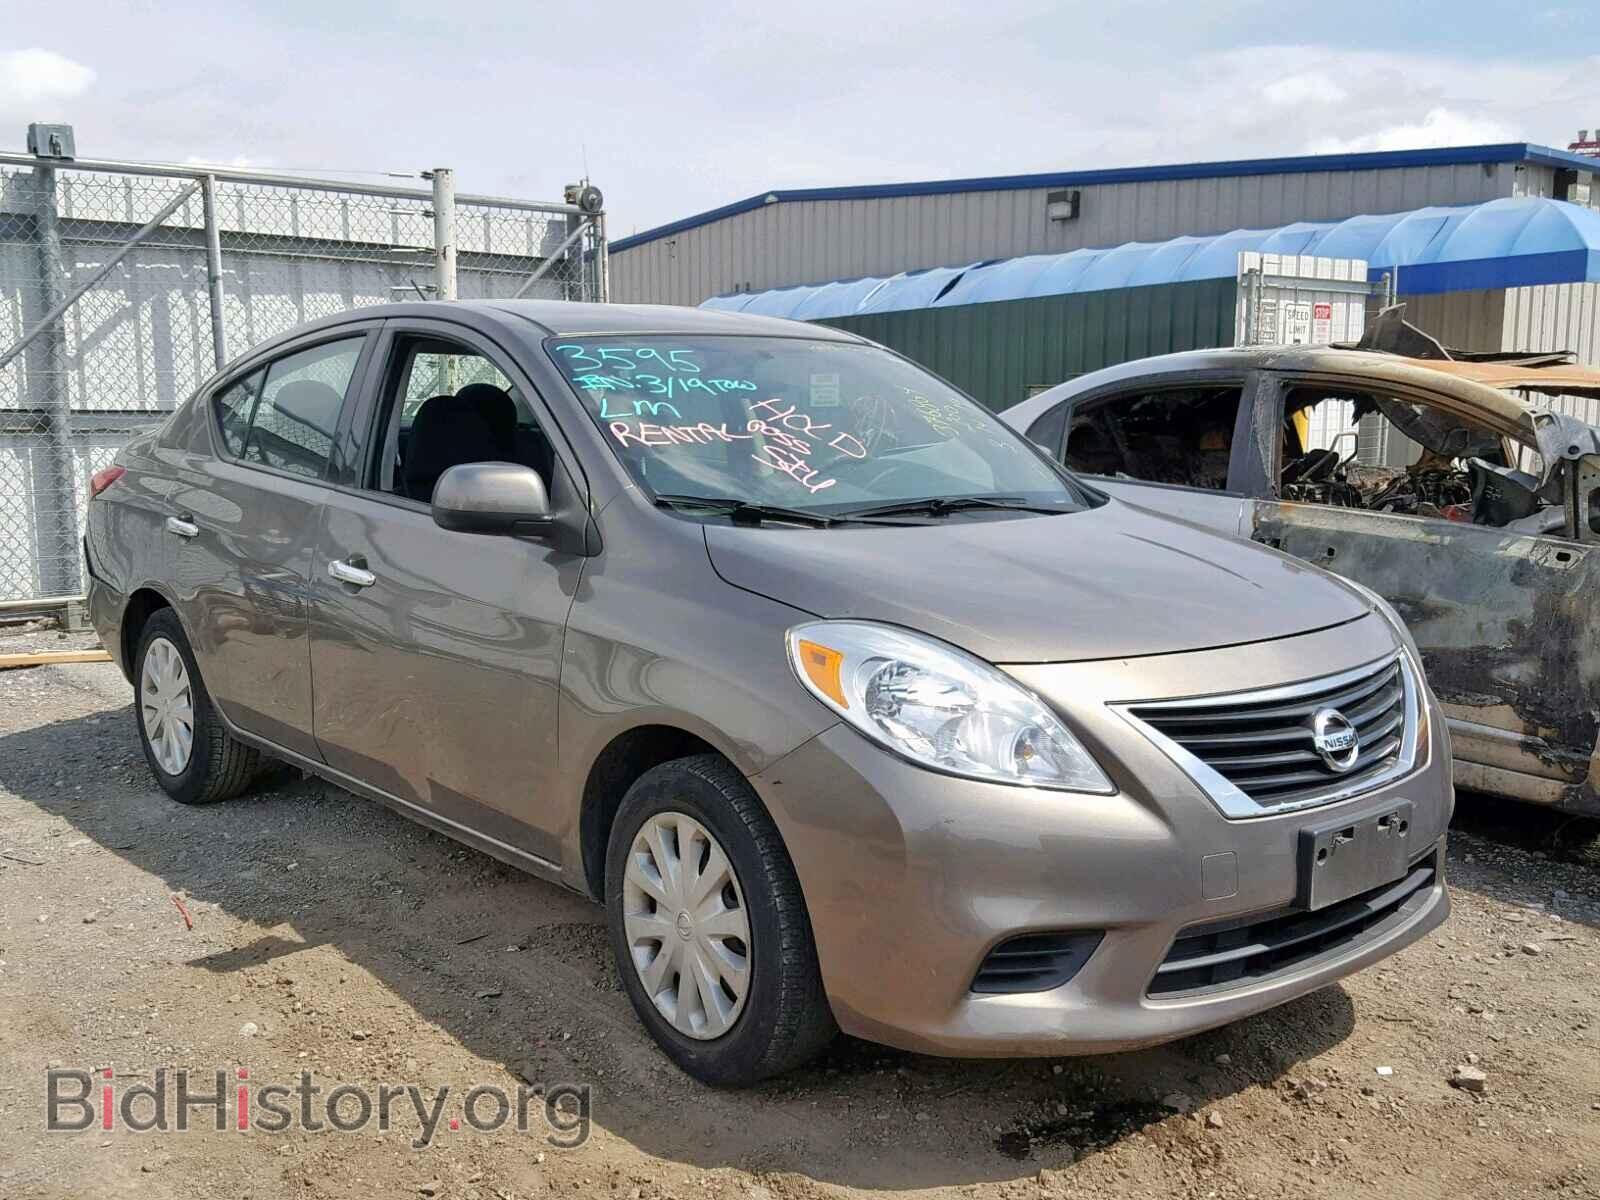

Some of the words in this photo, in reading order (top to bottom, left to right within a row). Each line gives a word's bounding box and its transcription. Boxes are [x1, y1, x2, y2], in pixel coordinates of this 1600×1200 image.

[1287, 309, 1309, 320] SPEED
[556, 345, 701, 373] 3595
[610, 421, 753, 447] RENTAL
